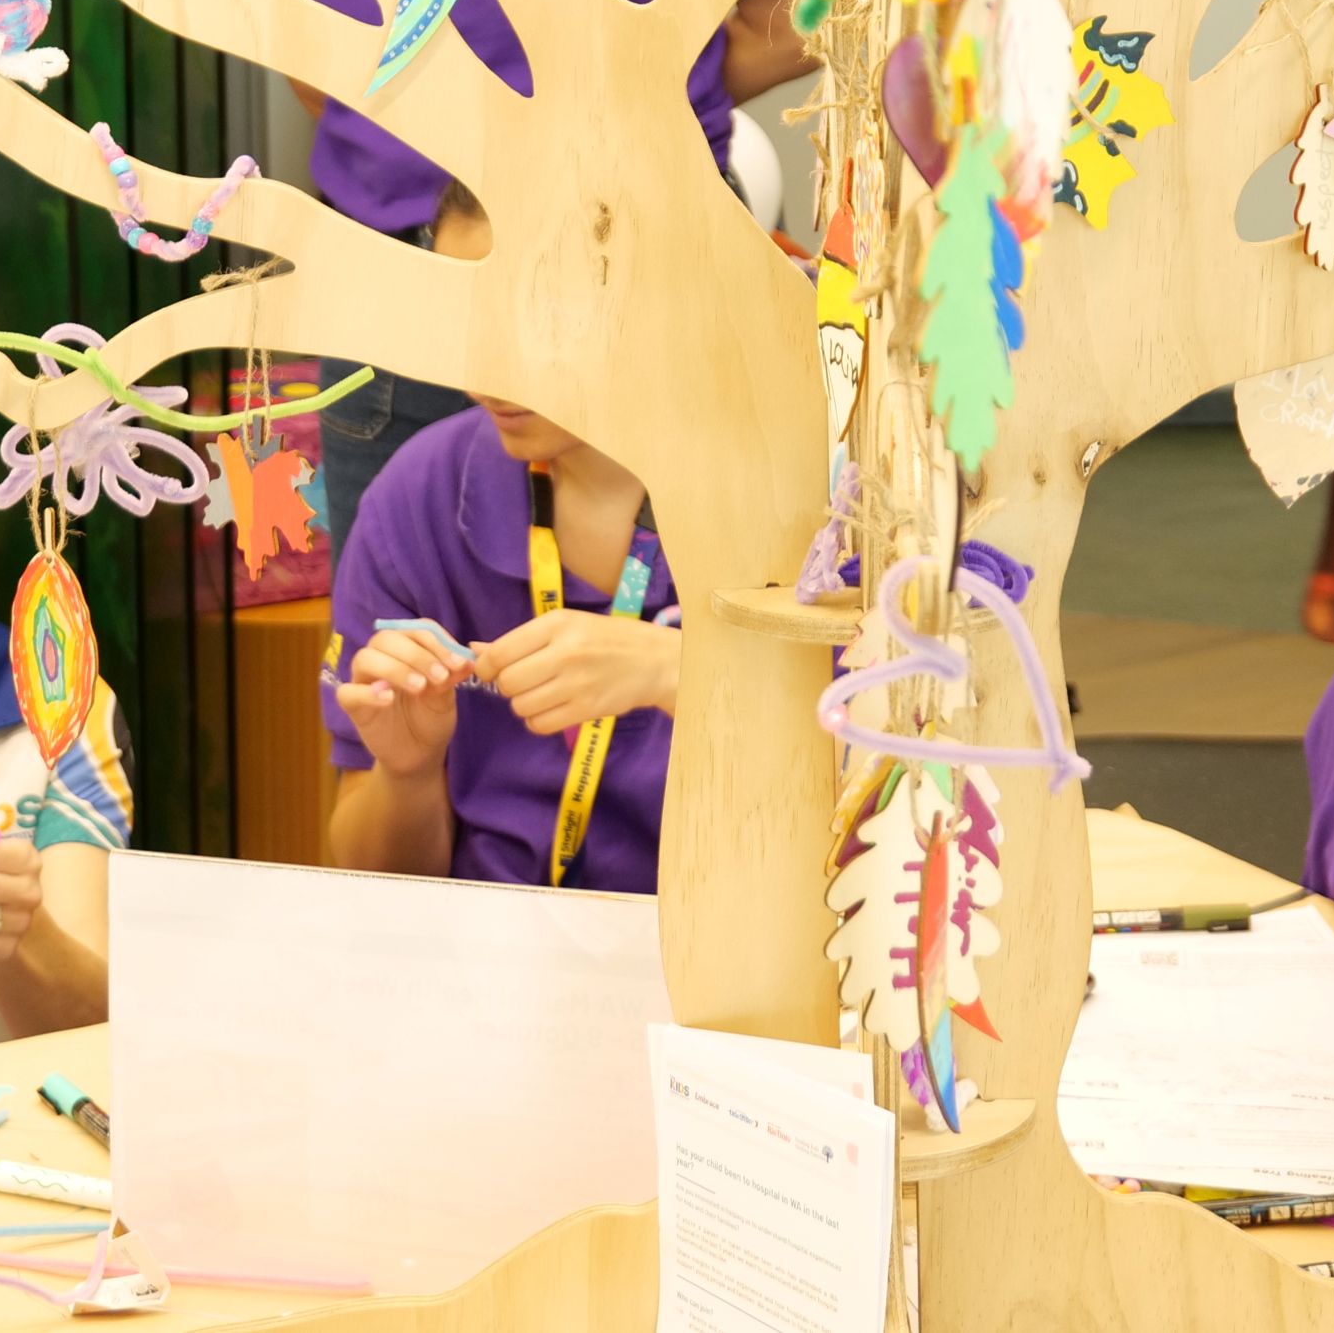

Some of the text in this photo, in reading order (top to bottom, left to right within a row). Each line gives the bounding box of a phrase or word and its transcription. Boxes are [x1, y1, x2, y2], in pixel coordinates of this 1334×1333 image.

[572, 732, 602, 803] Happiness
[706, 1157, 722, 1172] child
[752, 1179, 780, 1202] hospital
[812, 1207, 824, 1222] the
